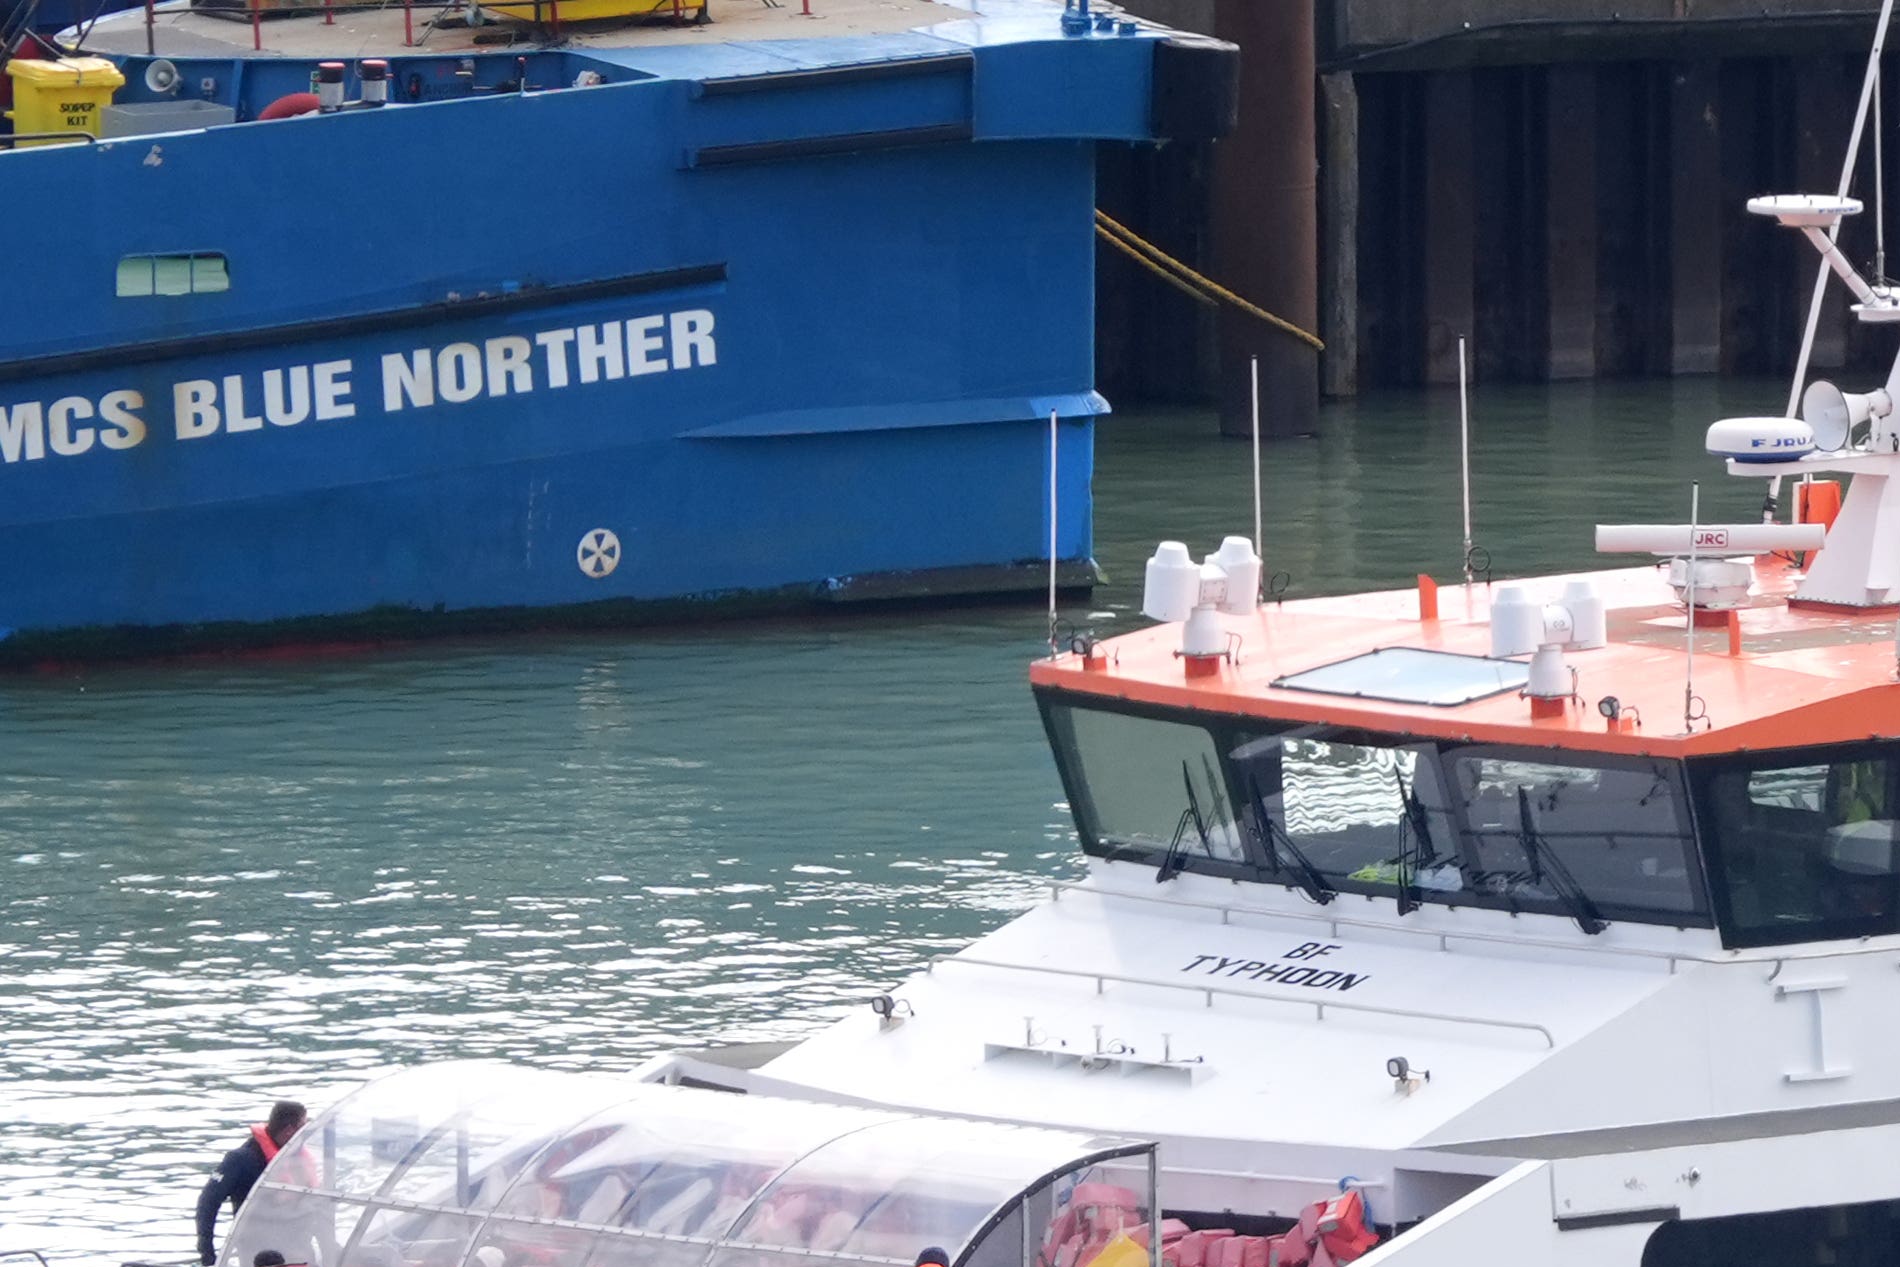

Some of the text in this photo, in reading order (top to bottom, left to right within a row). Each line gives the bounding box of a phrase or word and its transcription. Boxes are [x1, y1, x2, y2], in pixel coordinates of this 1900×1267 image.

[67, 115, 88, 126] KIT
[0, 309, 717, 464] MCS BLUE NORTHER
[1695, 533, 1725, 545] JRC
[1281, 941, 1343, 962] BF
[1180, 954, 1372, 992] TYPHOON
